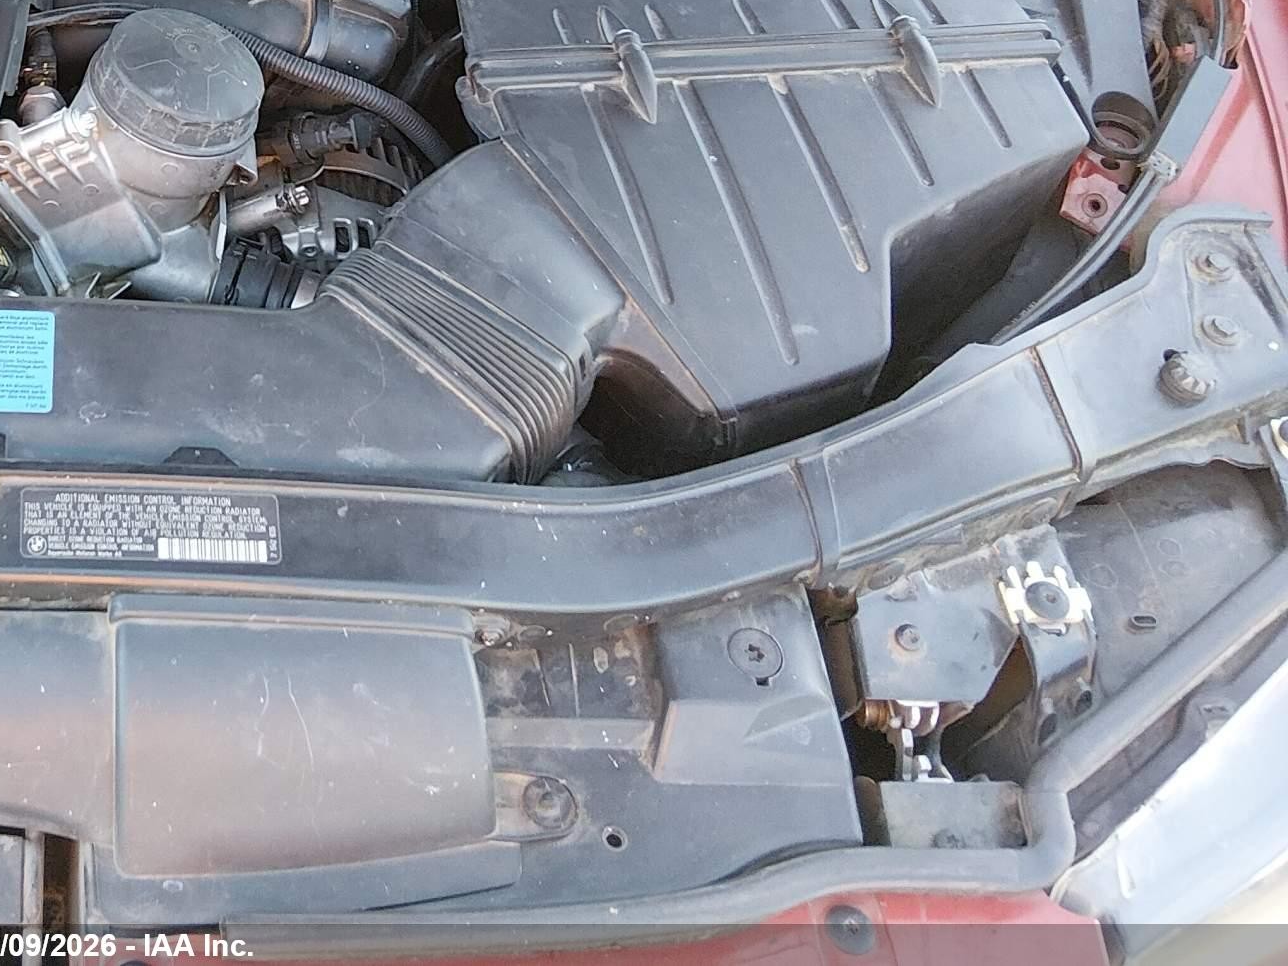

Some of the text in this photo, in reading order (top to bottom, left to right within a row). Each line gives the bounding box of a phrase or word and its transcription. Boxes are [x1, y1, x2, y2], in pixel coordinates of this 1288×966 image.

[55, 493, 231, 506] ADDITIONAL EMISSION CONTROL INFORMATION
[24, 502, 40, 510] THIS
[44, 502, 72, 510] VEHICLE
[125, 504, 143, 513] WITH
[147, 505, 156, 513] AN
[135, 513, 164, 521] VEHICLE
[168, 514, 201, 522] EMISSION
[204, 515, 233, 523] CONTROL
[63, 519, 71, 527] TO
[83, 519, 118, 527] RADIATOR
[122, 520, 151, 529] WITHOUT
[156, 521, 199, 530] EQUIVALENT
[228, 523, 266, 532] REDUCTION
[90, 527, 128, 536] VIOLATION
[160, 530, 199, 538] POLLUTION
